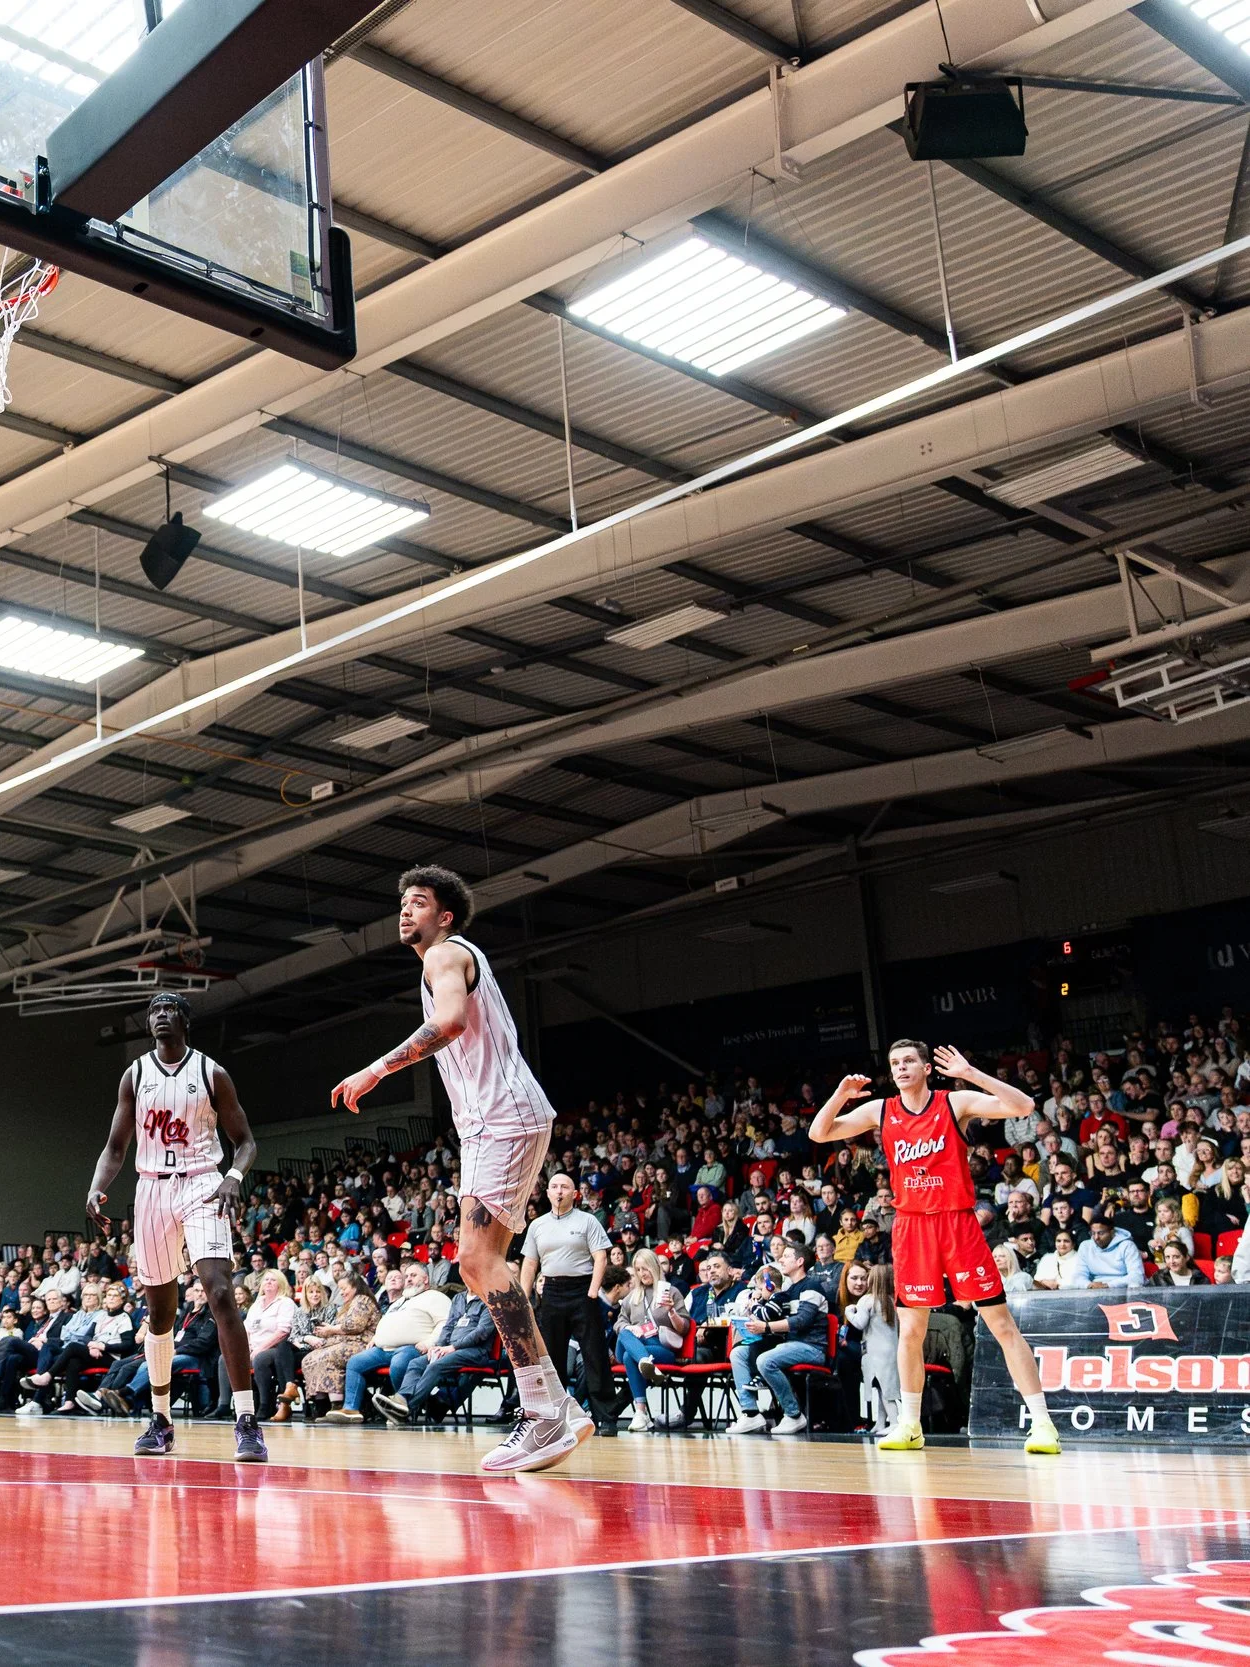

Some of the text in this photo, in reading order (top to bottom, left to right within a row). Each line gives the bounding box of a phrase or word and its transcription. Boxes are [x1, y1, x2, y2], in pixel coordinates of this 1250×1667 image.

[1062, 940, 1072, 955] 6
[1060, 982, 1070, 997] 2
[143, 1109, 190, 1148] Mcr
[893, 1135, 946, 1166] Riders
[912, 1284, 934, 1292] VERTU
